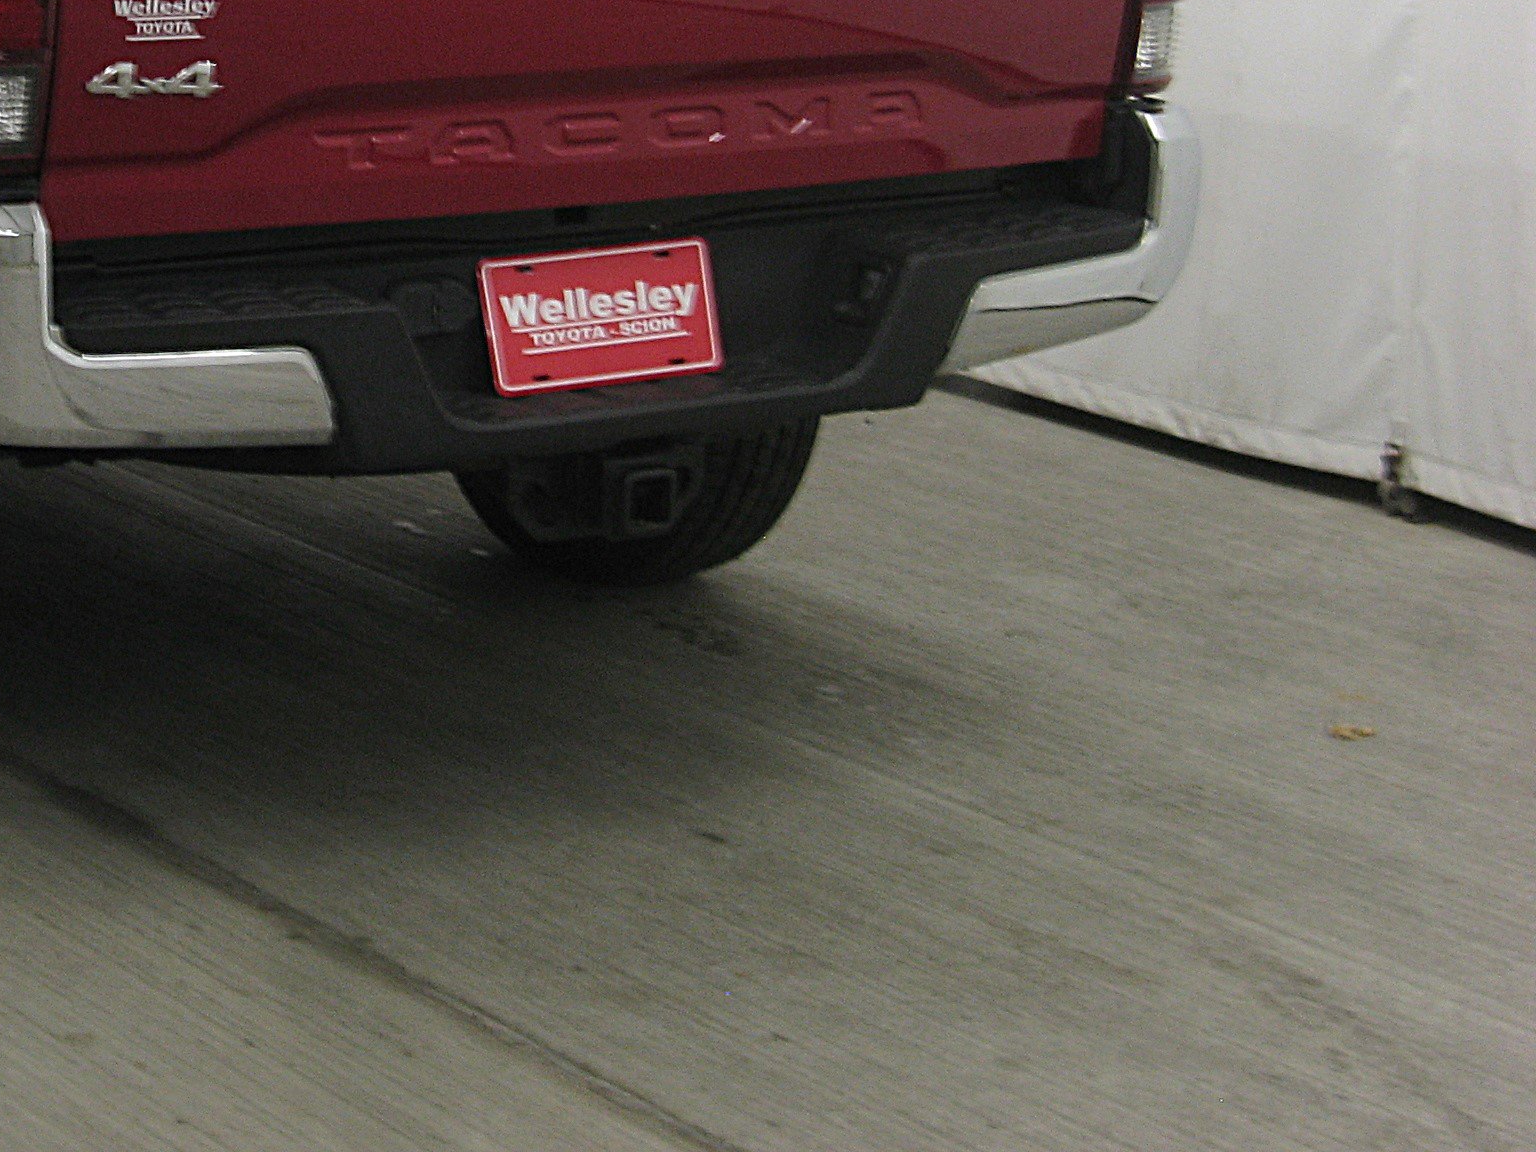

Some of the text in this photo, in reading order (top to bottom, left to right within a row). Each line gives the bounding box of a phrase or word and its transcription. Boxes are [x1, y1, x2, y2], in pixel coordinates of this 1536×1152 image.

[136, 21, 195, 35] TOYOTA
[86, 60, 224, 98] 4x4
[313, 90, 923, 171] TACOMA
[499, 280, 698, 327] Wellesley
[531, 326, 605, 346] TOYOTA
[620, 316, 676, 336] SCION
